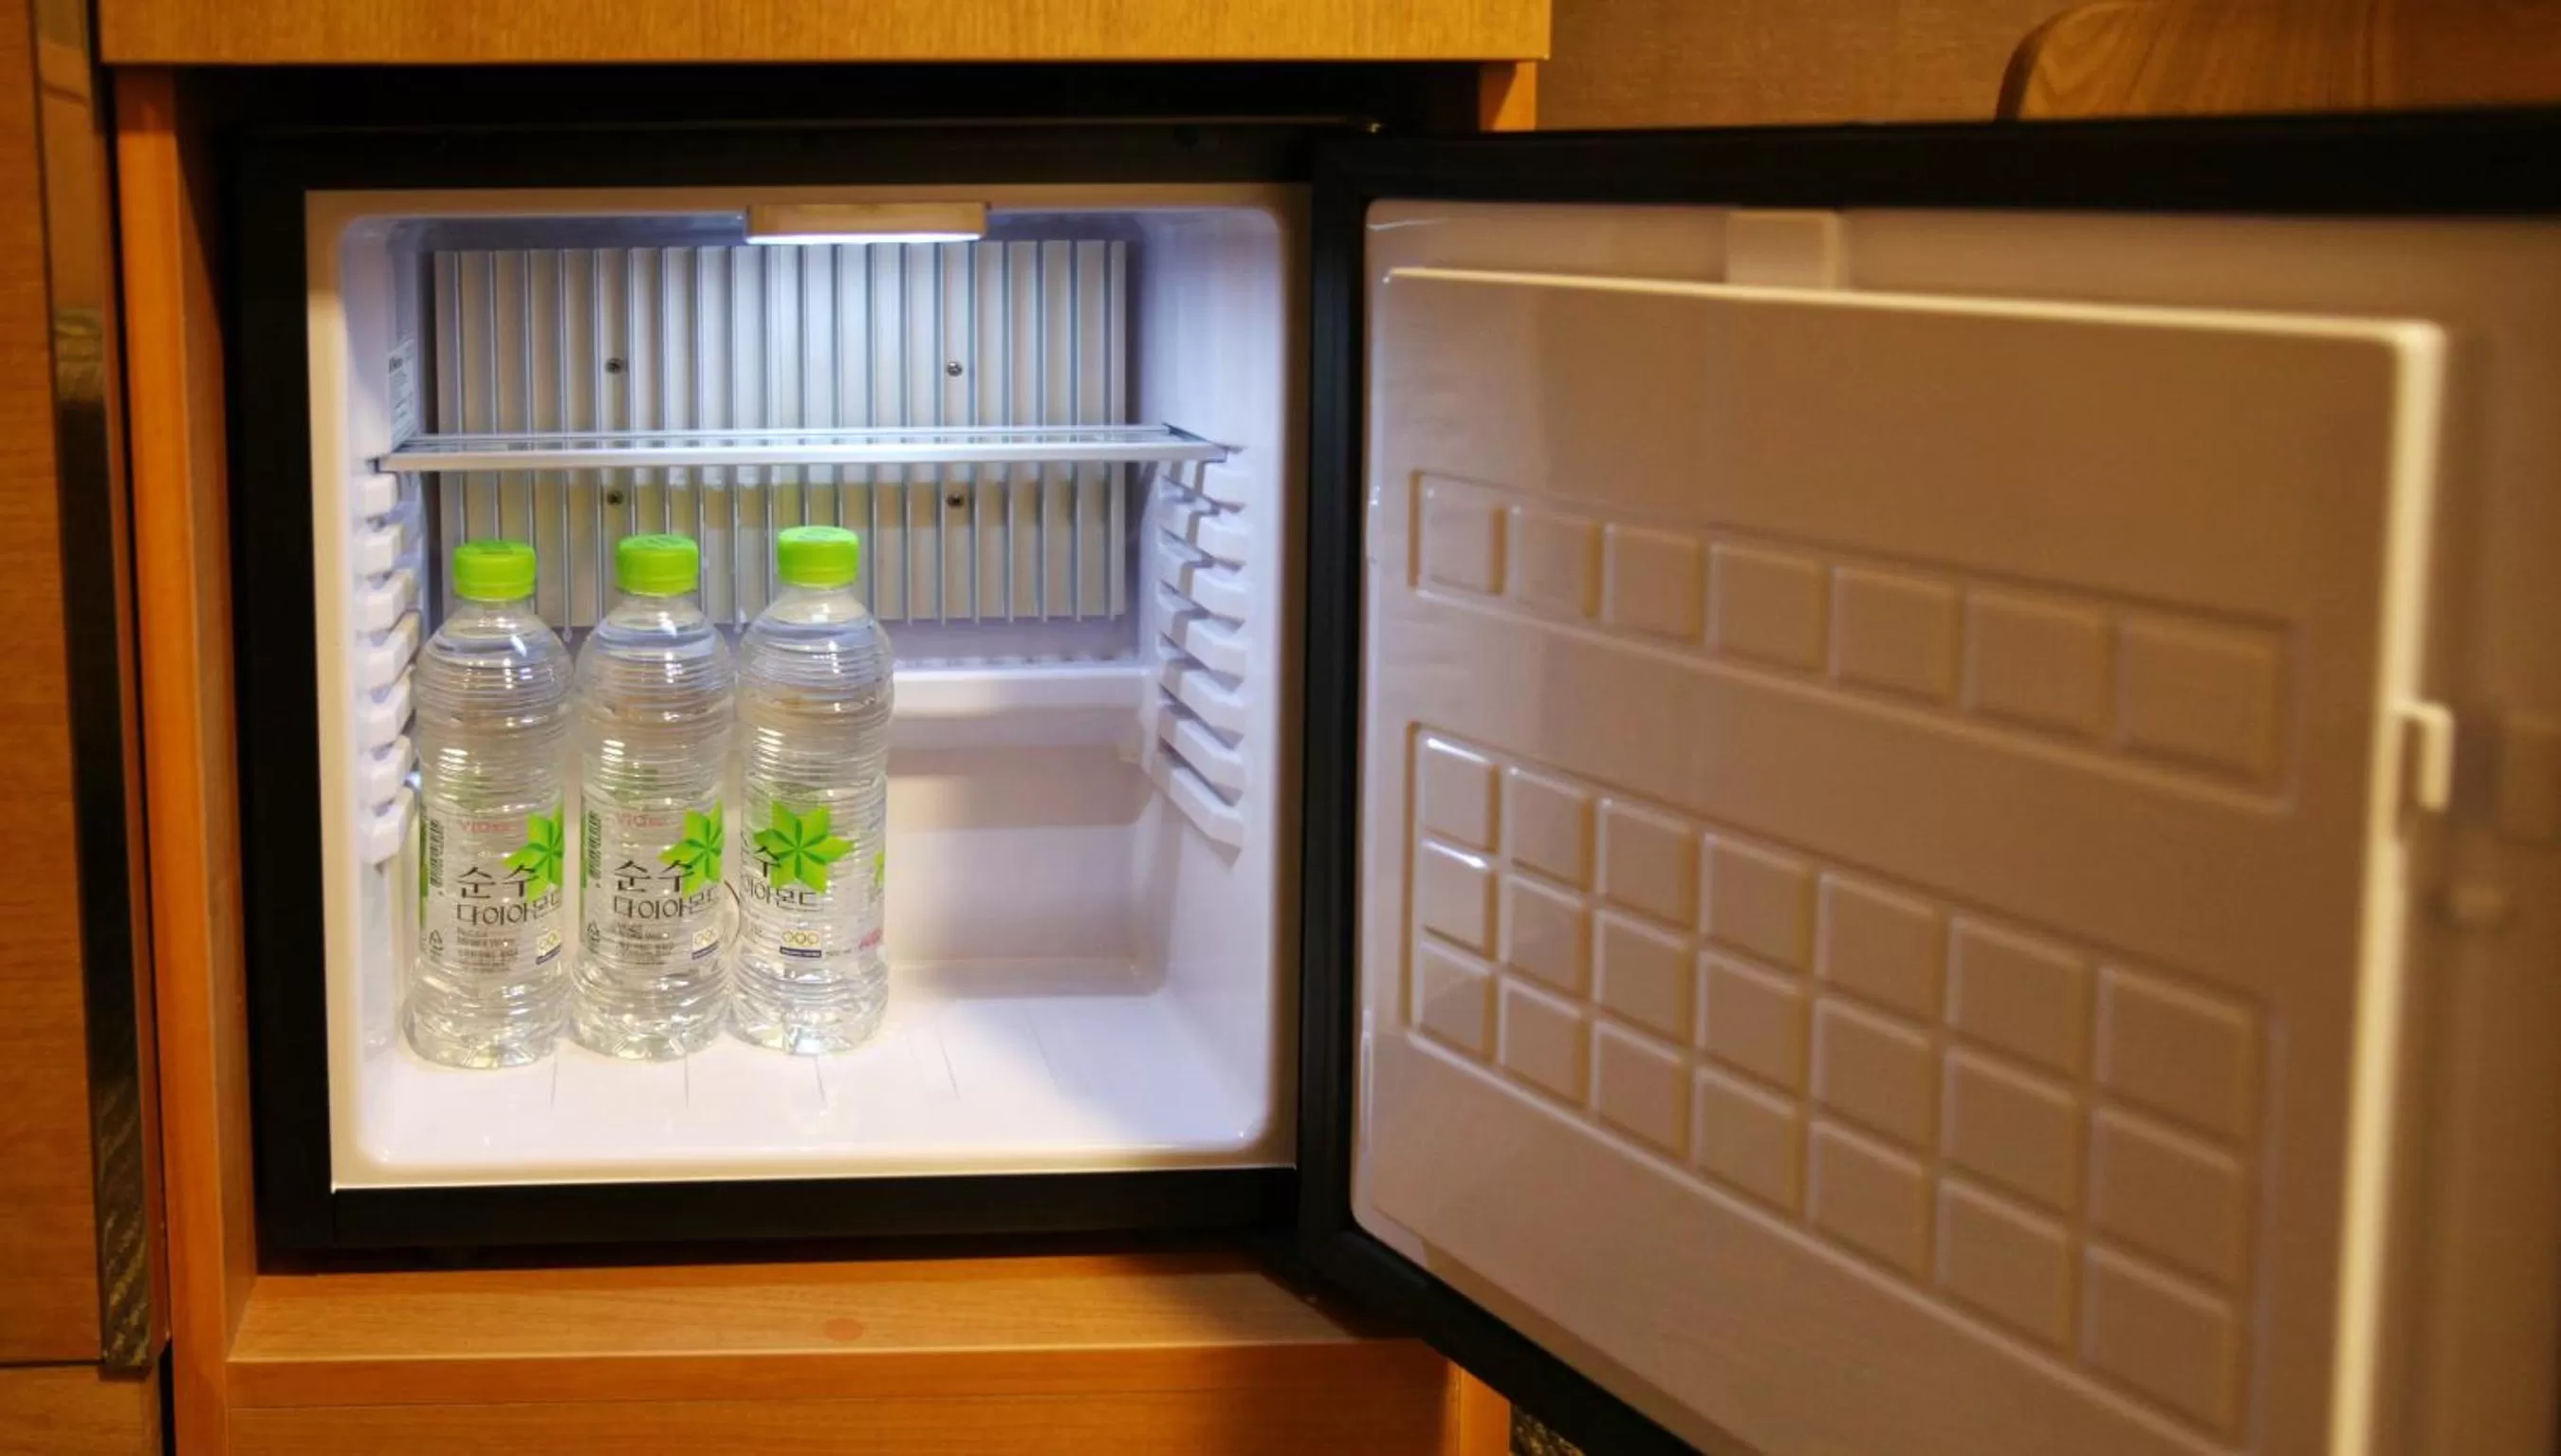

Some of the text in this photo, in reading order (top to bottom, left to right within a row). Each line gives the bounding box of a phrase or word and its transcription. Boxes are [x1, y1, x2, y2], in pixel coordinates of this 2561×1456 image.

[614, 859, 695, 893] 순수
[751, 845, 782, 878] 수
[455, 864, 540, 899] 순수
